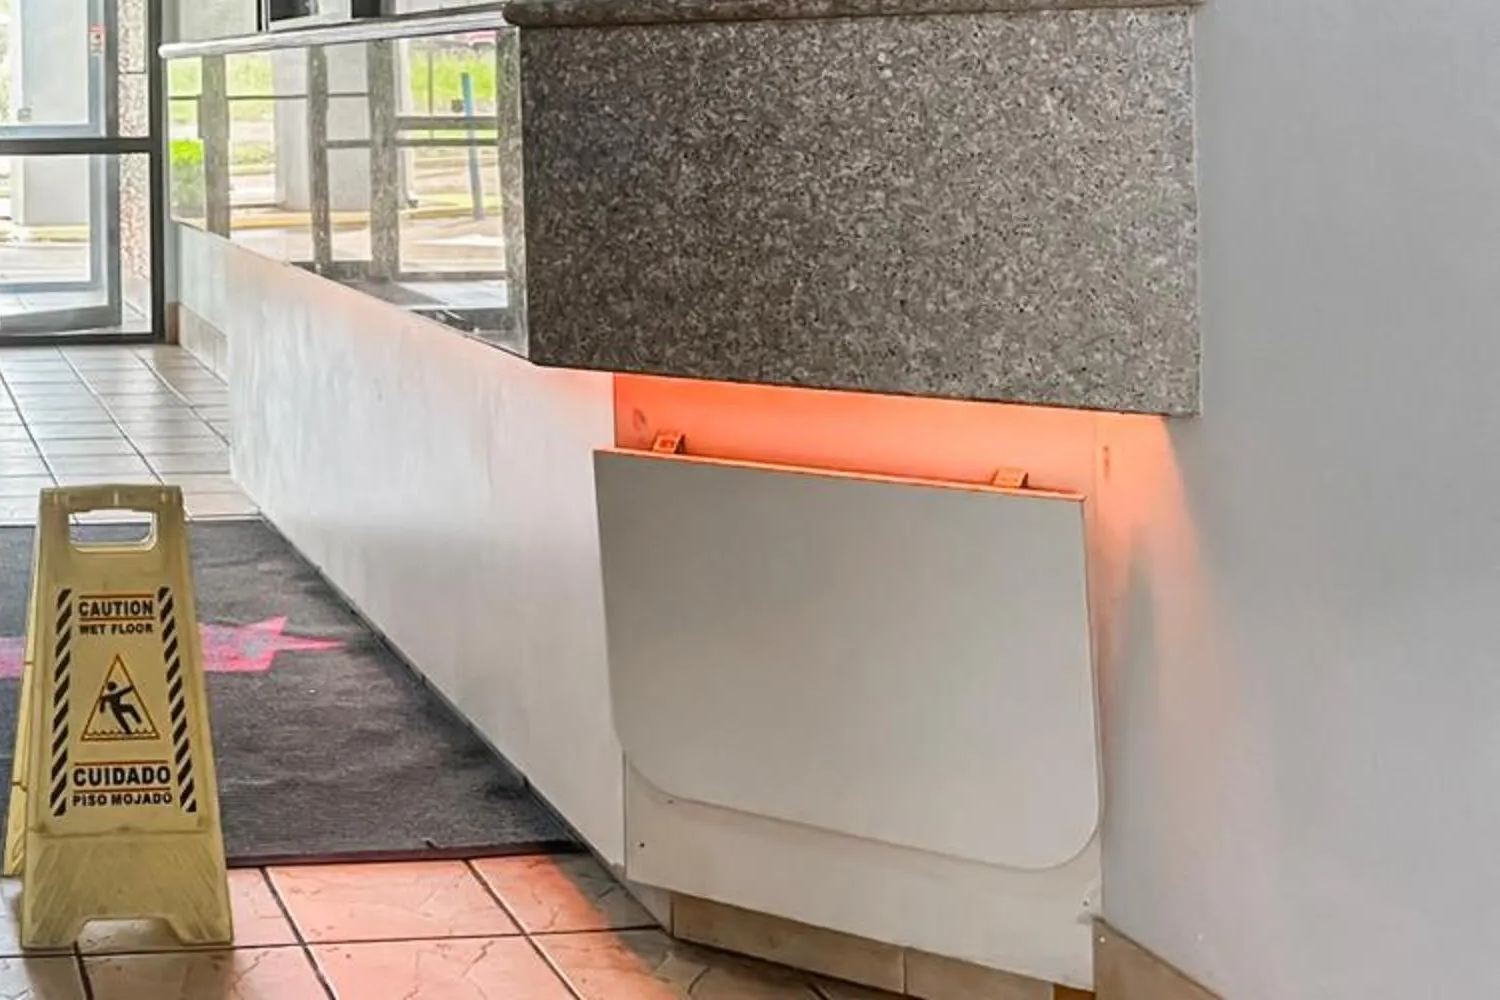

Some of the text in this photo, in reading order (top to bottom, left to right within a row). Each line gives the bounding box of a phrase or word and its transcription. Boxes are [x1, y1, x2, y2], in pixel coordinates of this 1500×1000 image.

[78, 601, 153, 617] CAUTION
[79, 623, 153, 635] WET FLOOR
[73, 766, 171, 787] CUIDADO
[73, 792, 173, 806] PISO MOJADO
